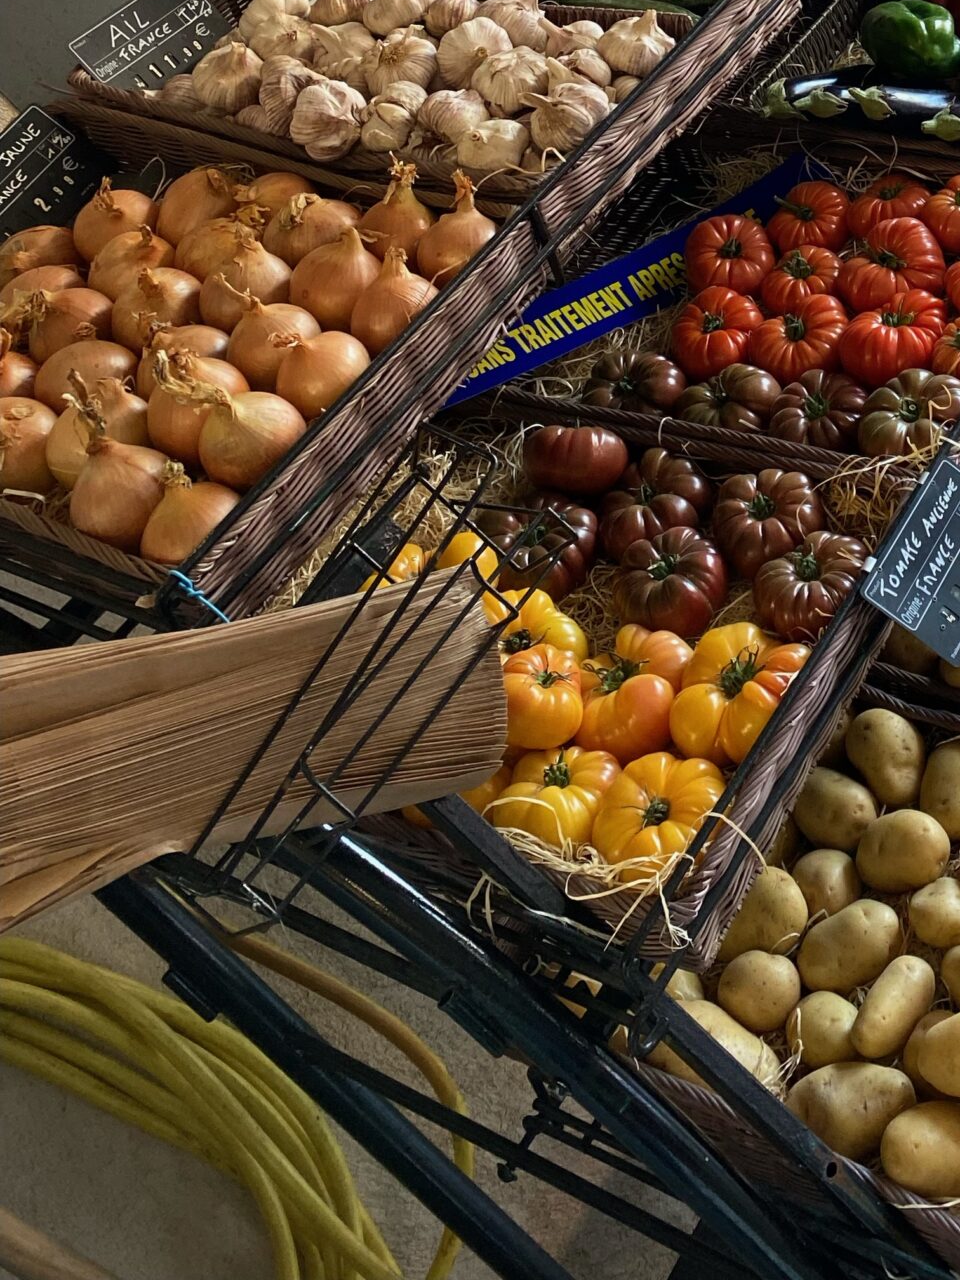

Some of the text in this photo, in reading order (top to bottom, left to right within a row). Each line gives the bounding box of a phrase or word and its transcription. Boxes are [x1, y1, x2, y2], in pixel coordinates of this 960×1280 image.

[95, 57, 123, 79] Origine:
[118, 21, 173, 62] FRANCE
[148, 22, 211, 79] 11,99 €
[0, 123, 41, 167] JAUNE
[62, 155, 80, 172] €
[508, 281, 633, 355] TRAITEMENT
[627, 251, 687, 303] APRES
[879, 477, 959, 599] TOMATE ANCIENNE
[901, 591, 926, 625] Origine:
[915, 533, 956, 597] FRANCE
